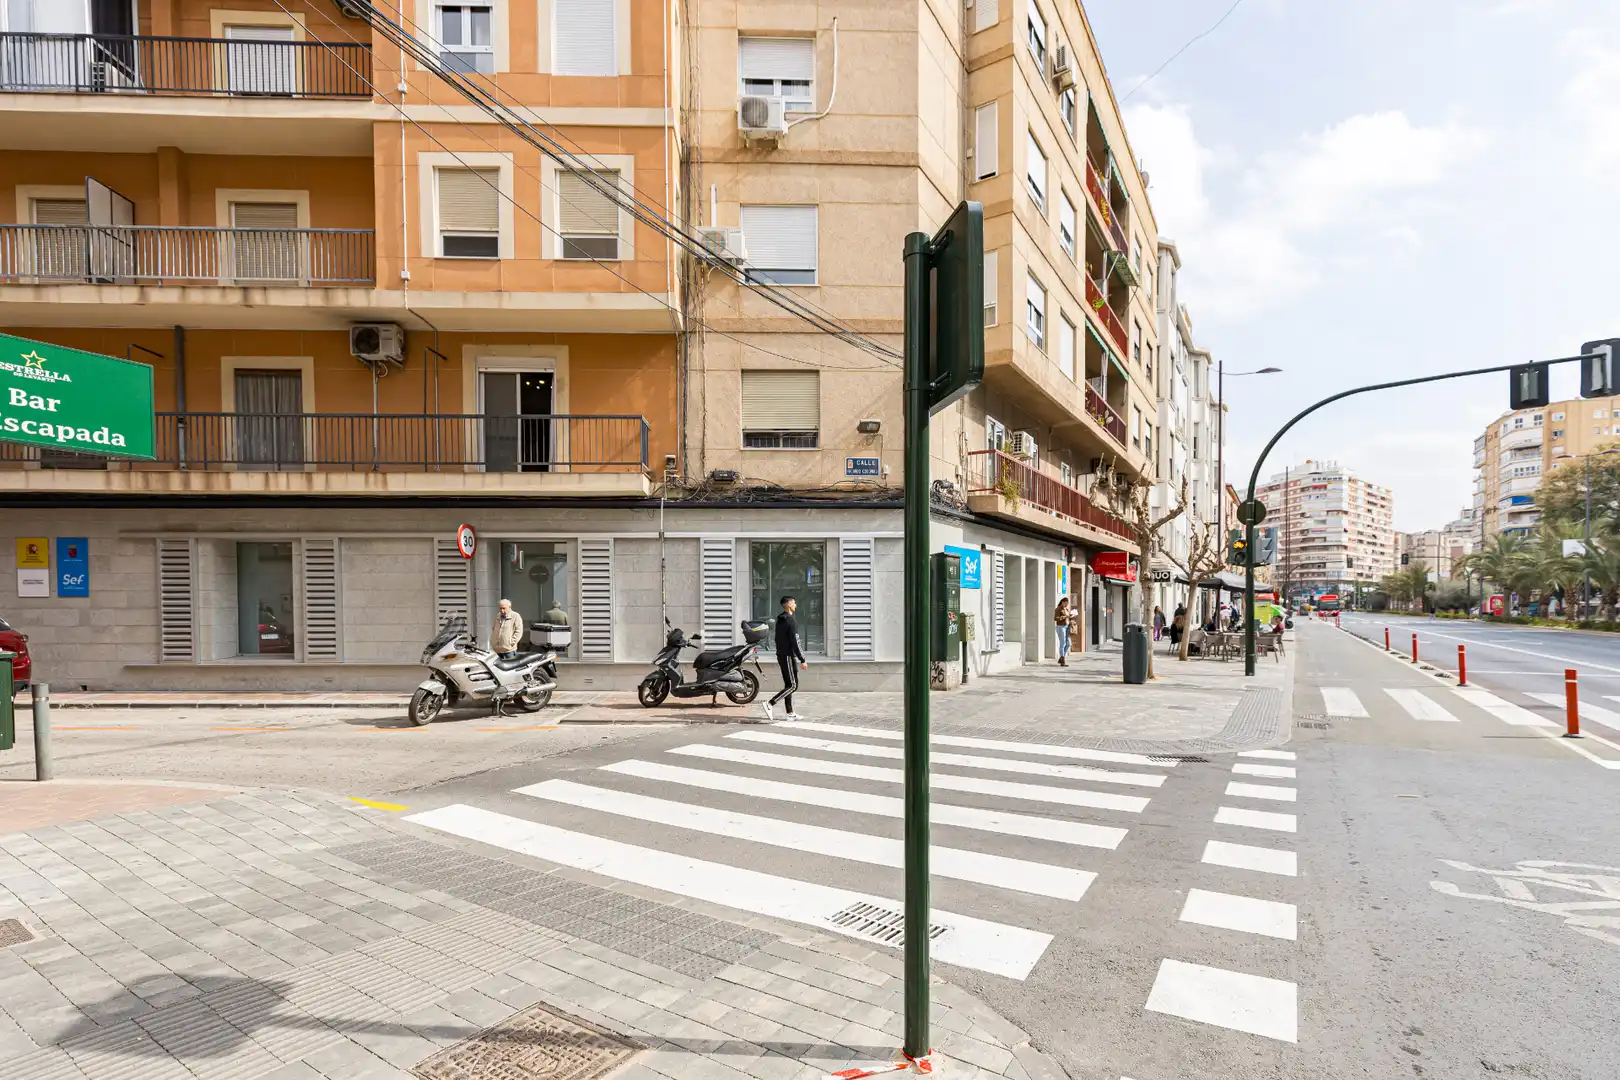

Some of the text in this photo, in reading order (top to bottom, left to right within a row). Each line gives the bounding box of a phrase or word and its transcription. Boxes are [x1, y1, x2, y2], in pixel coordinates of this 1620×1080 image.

[8, 387, 61, 412] Bar
[0, 412, 126, 447] scapada
[463, 536, 473, 547] 30
[965, 556, 978, 575] Sef
[62, 574, 85, 585] Sef
